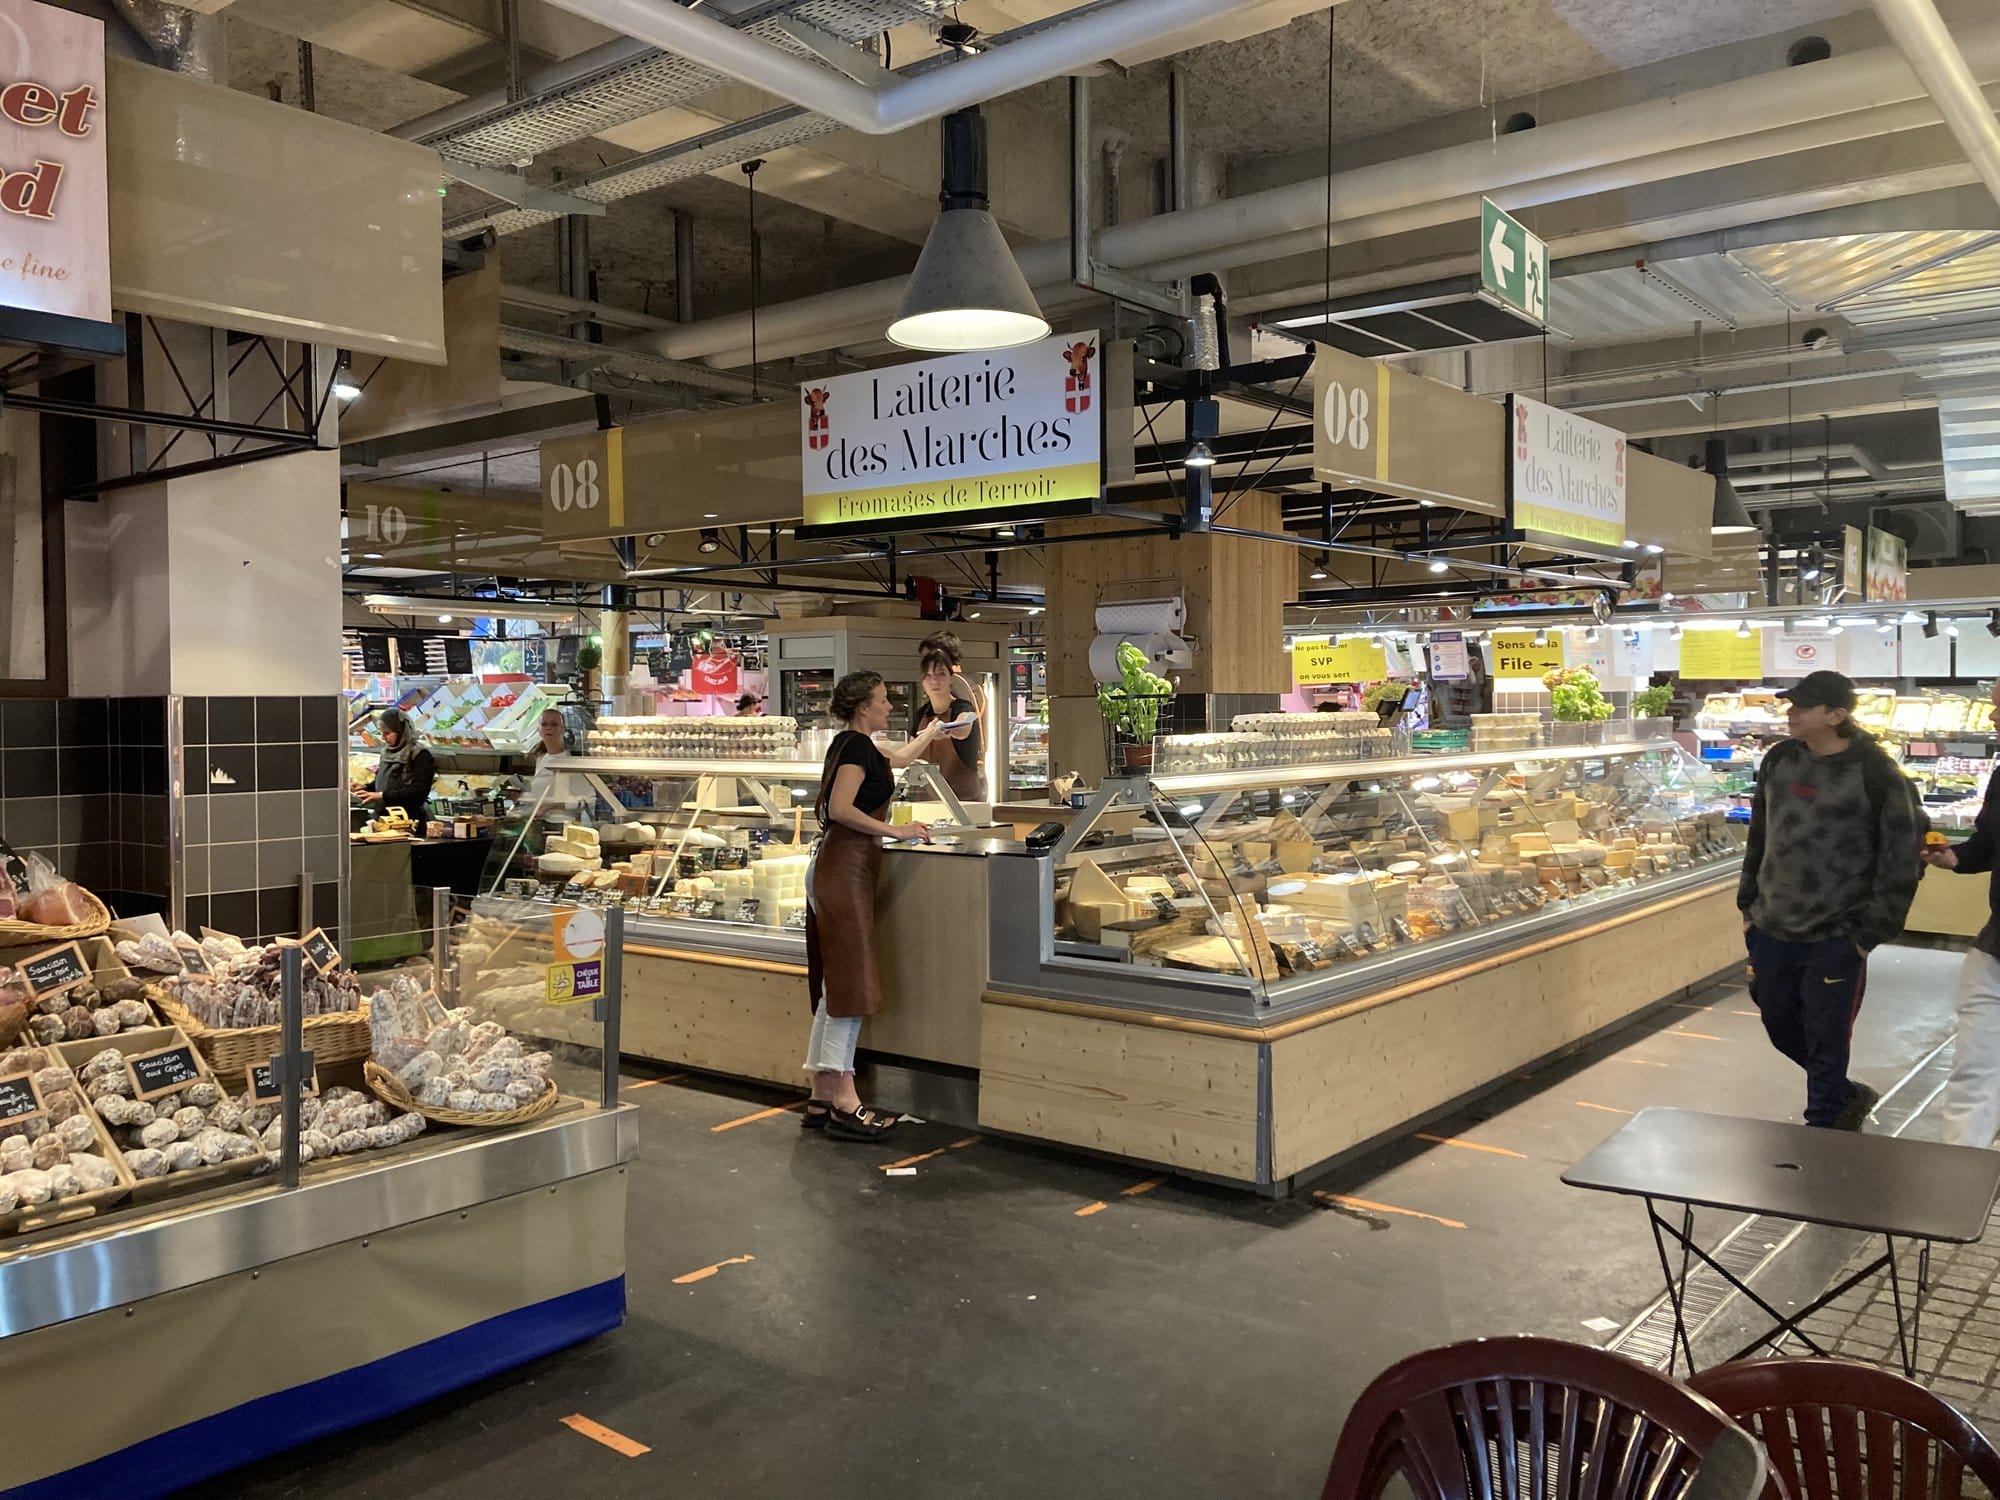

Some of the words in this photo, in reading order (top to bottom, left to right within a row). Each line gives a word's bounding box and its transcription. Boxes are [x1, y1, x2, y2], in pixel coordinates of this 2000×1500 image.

[0, 82, 97, 137] et
[0, 160, 64, 220] d
[21, 252, 70, 281] fine
[872, 359, 1015, 420] Laiterie
[1324, 380, 1370, 450] 08
[1546, 413, 1601, 462] Laiterie
[826, 437, 888, 480] des
[901, 414, 1072, 471] Marches
[550, 459, 599, 512] 08
[838, 489, 935, 517] Fromages
[943, 484, 967, 507] de
[974, 474, 1057, 503] Terroir
[1525, 456, 1553, 496] des
[1558, 463, 1618, 512] Marches
[365, 505, 406, 544] 10
[1310, 657, 1333, 666] SVP
[1497, 640, 1526, 649] Sens
[1547, 639, 1558, 648] la
[1500, 657, 1533, 670] File
[576, 979, 599, 990] TABLE
[139, 1055, 180, 1070] Saucisson
